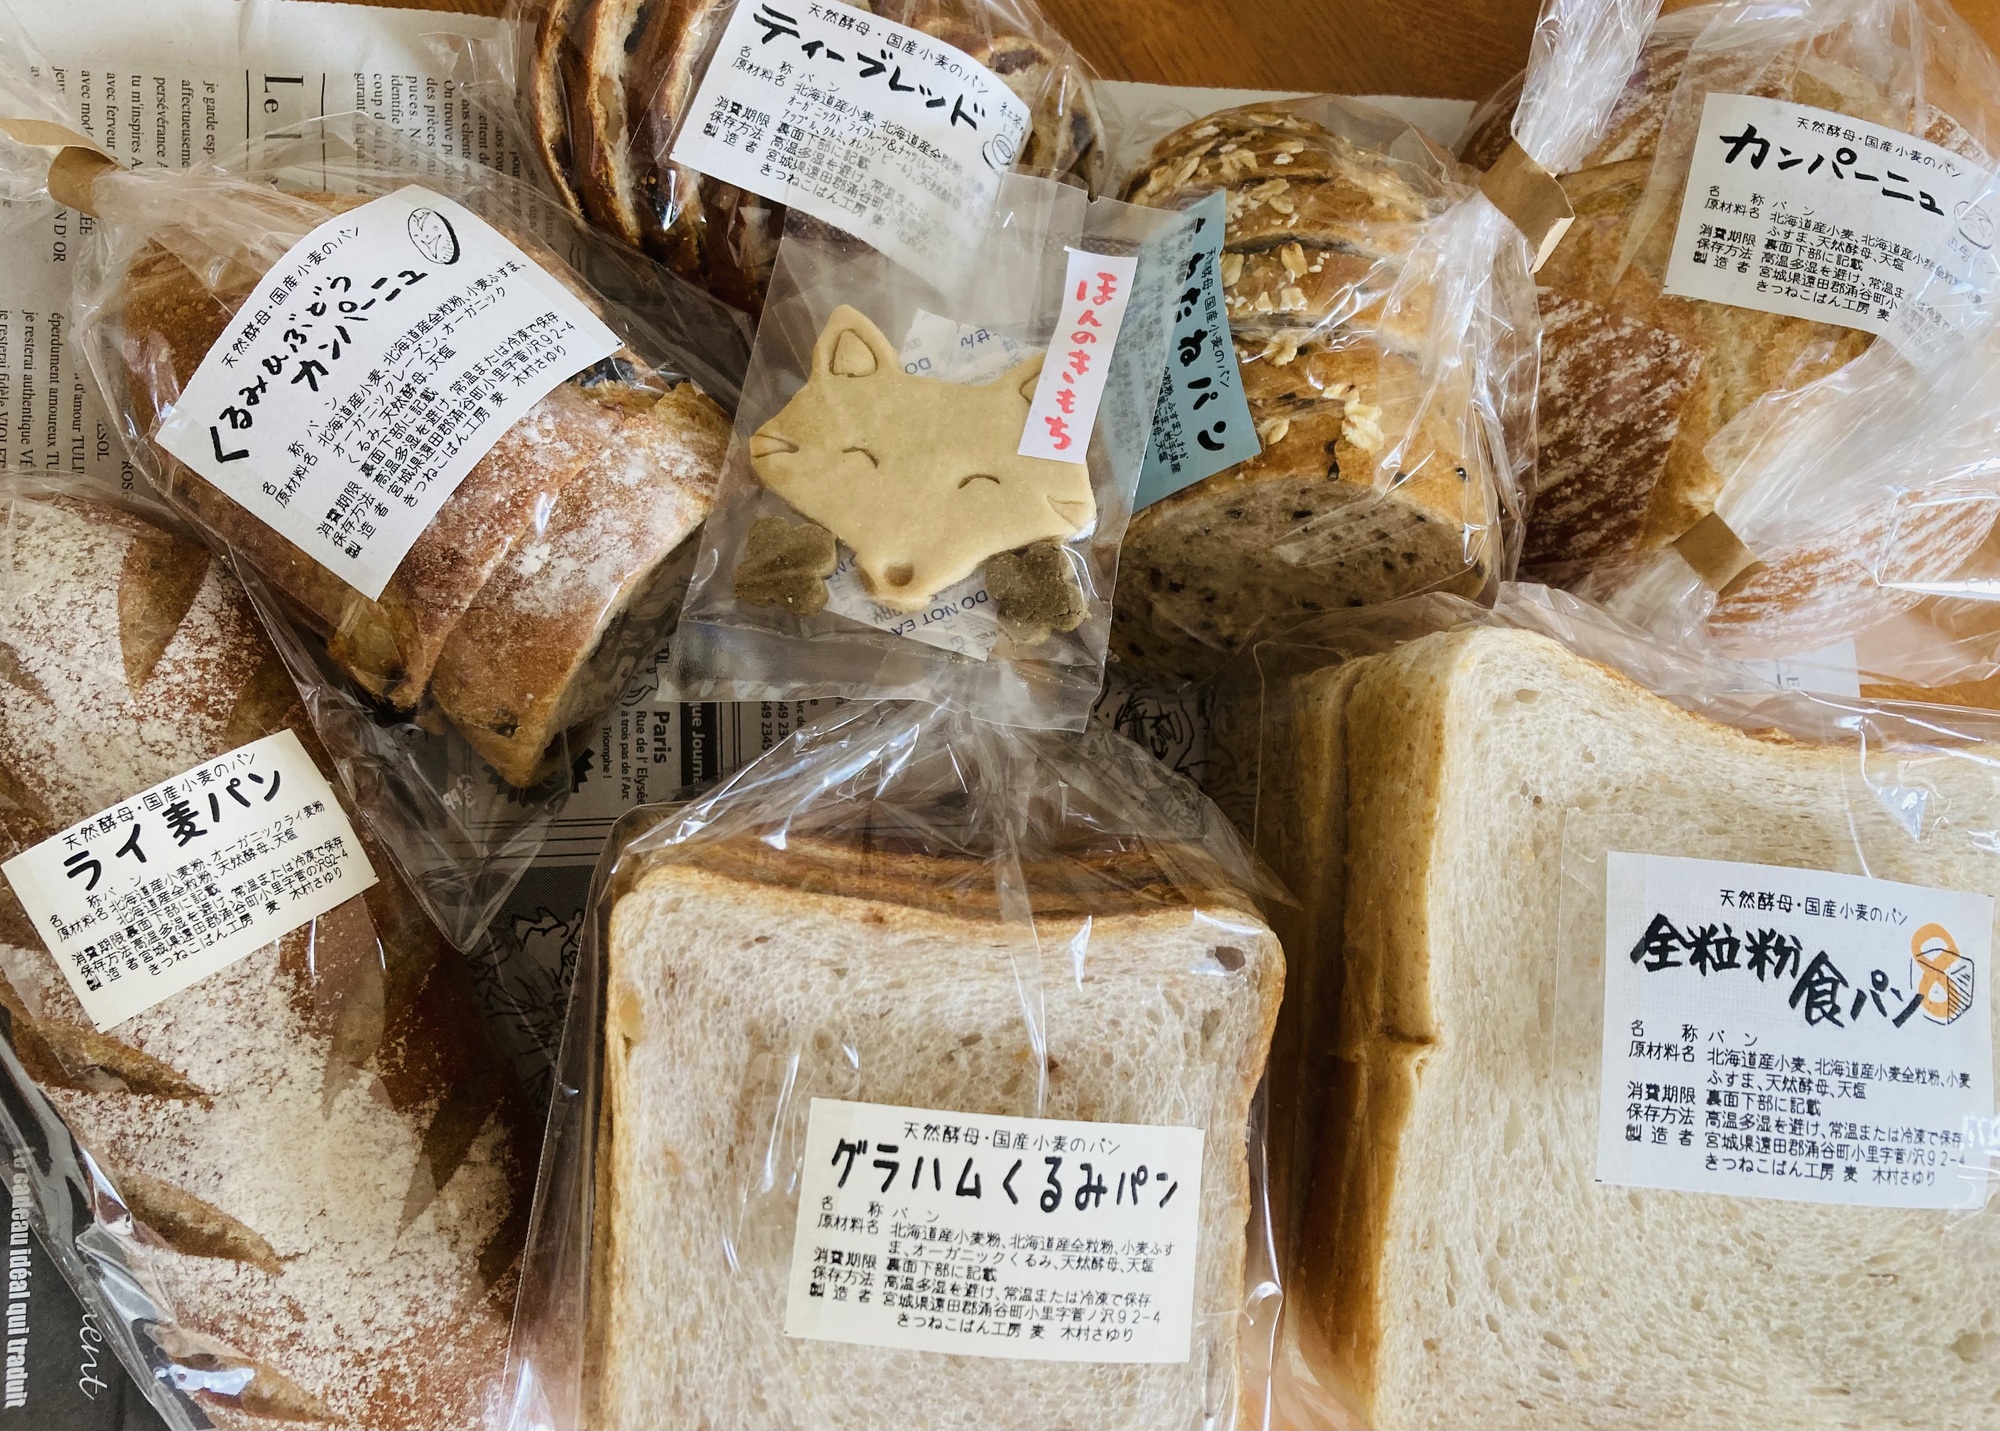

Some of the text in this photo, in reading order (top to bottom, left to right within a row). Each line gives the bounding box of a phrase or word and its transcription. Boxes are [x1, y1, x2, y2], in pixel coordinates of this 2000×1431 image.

[81, 70, 91, 98] avec
[106, 73, 116, 101] avec
[753, 3, 985, 131] ティーブレッド
[106, 105, 118, 149] ferveur
[153, 77, 170, 157] persévérance
[181, 80, 195, 168] affectueuseme
[202, 97, 218, 130] garde
[1719, 123, 1945, 216] カンパーニュ
[290, 269, 429, 394] カンパーニュ
[1044, 271, 1118, 451] ほんのきもち
[921, 598, 960, 622] NOT
[621, 719, 631, 740] trois
[636, 711, 648, 735] Rue
[636, 737, 648, 754] de
[653, 710, 671, 764] Paris
[600, 726, 613, 772] Triomphe
[618, 743, 629, 759] pas
[621, 762, 631, 774] de
[63, 769, 281, 891] ライ麦パン
[831, 1138, 1179, 1213] グラハムくるみパン
[8, 1249, 32, 1299] idéal
[6, 1302, 30, 1333] qui
[4, 1337, 29, 1408] traduit
